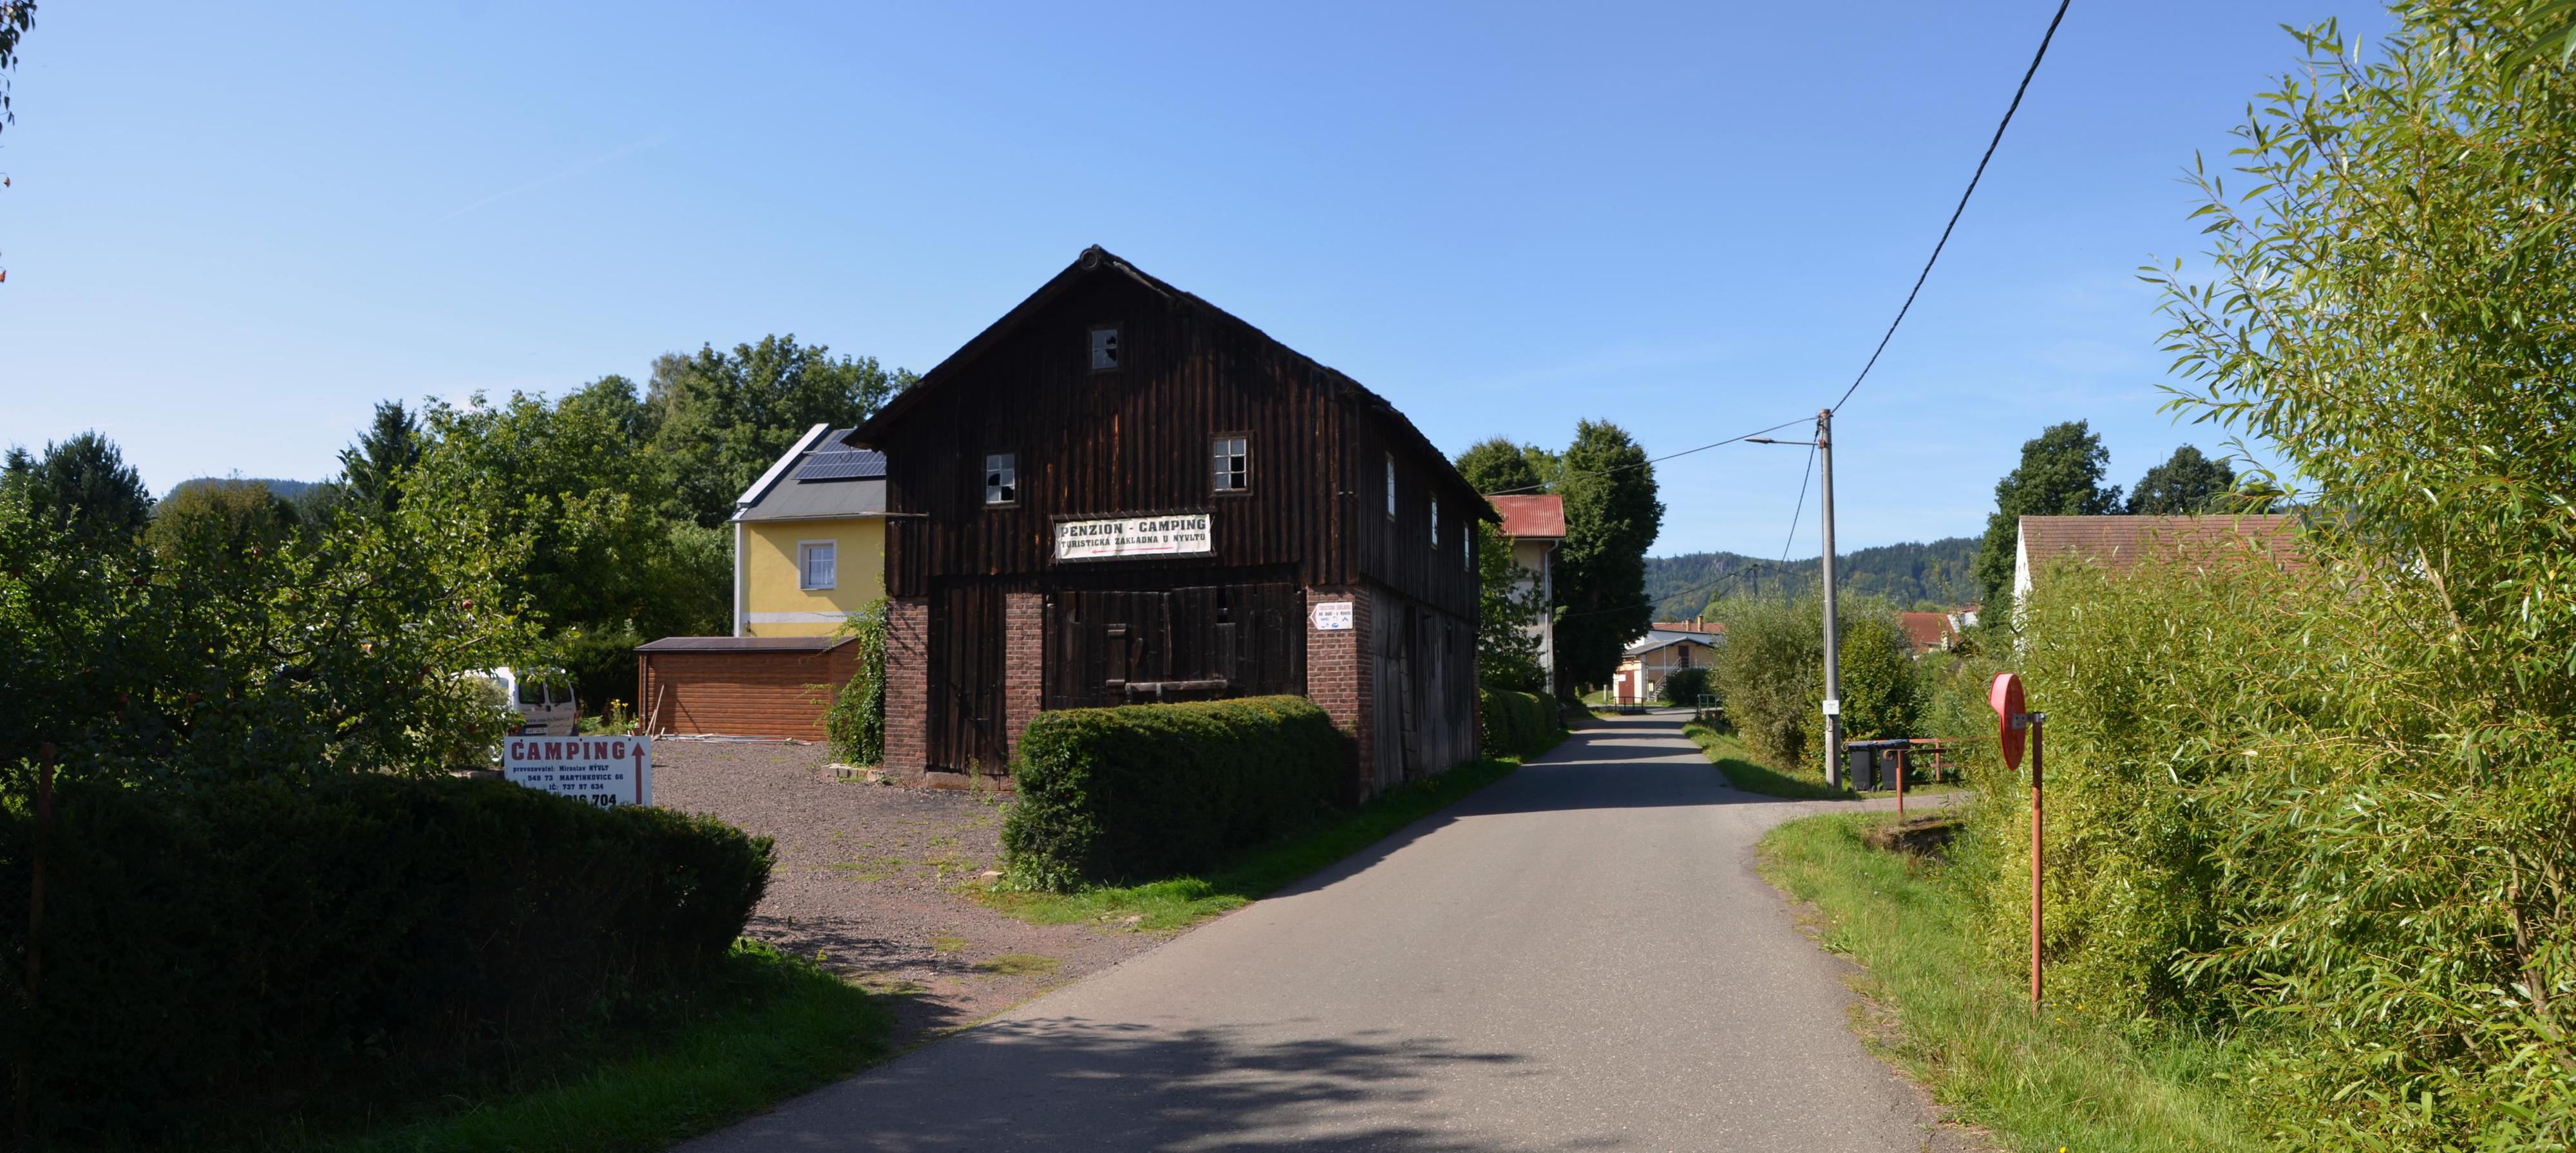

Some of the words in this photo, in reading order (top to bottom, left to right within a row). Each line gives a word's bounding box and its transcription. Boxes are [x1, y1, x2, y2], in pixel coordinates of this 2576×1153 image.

[1061, 523, 1123, 538] PENZION
[1139, 519, 1206, 532] CAMPING
[511, 741, 625, 760] CAMPING
[513, 765, 555, 773] provozovatel:
[592, 794, 616, 805] 704
